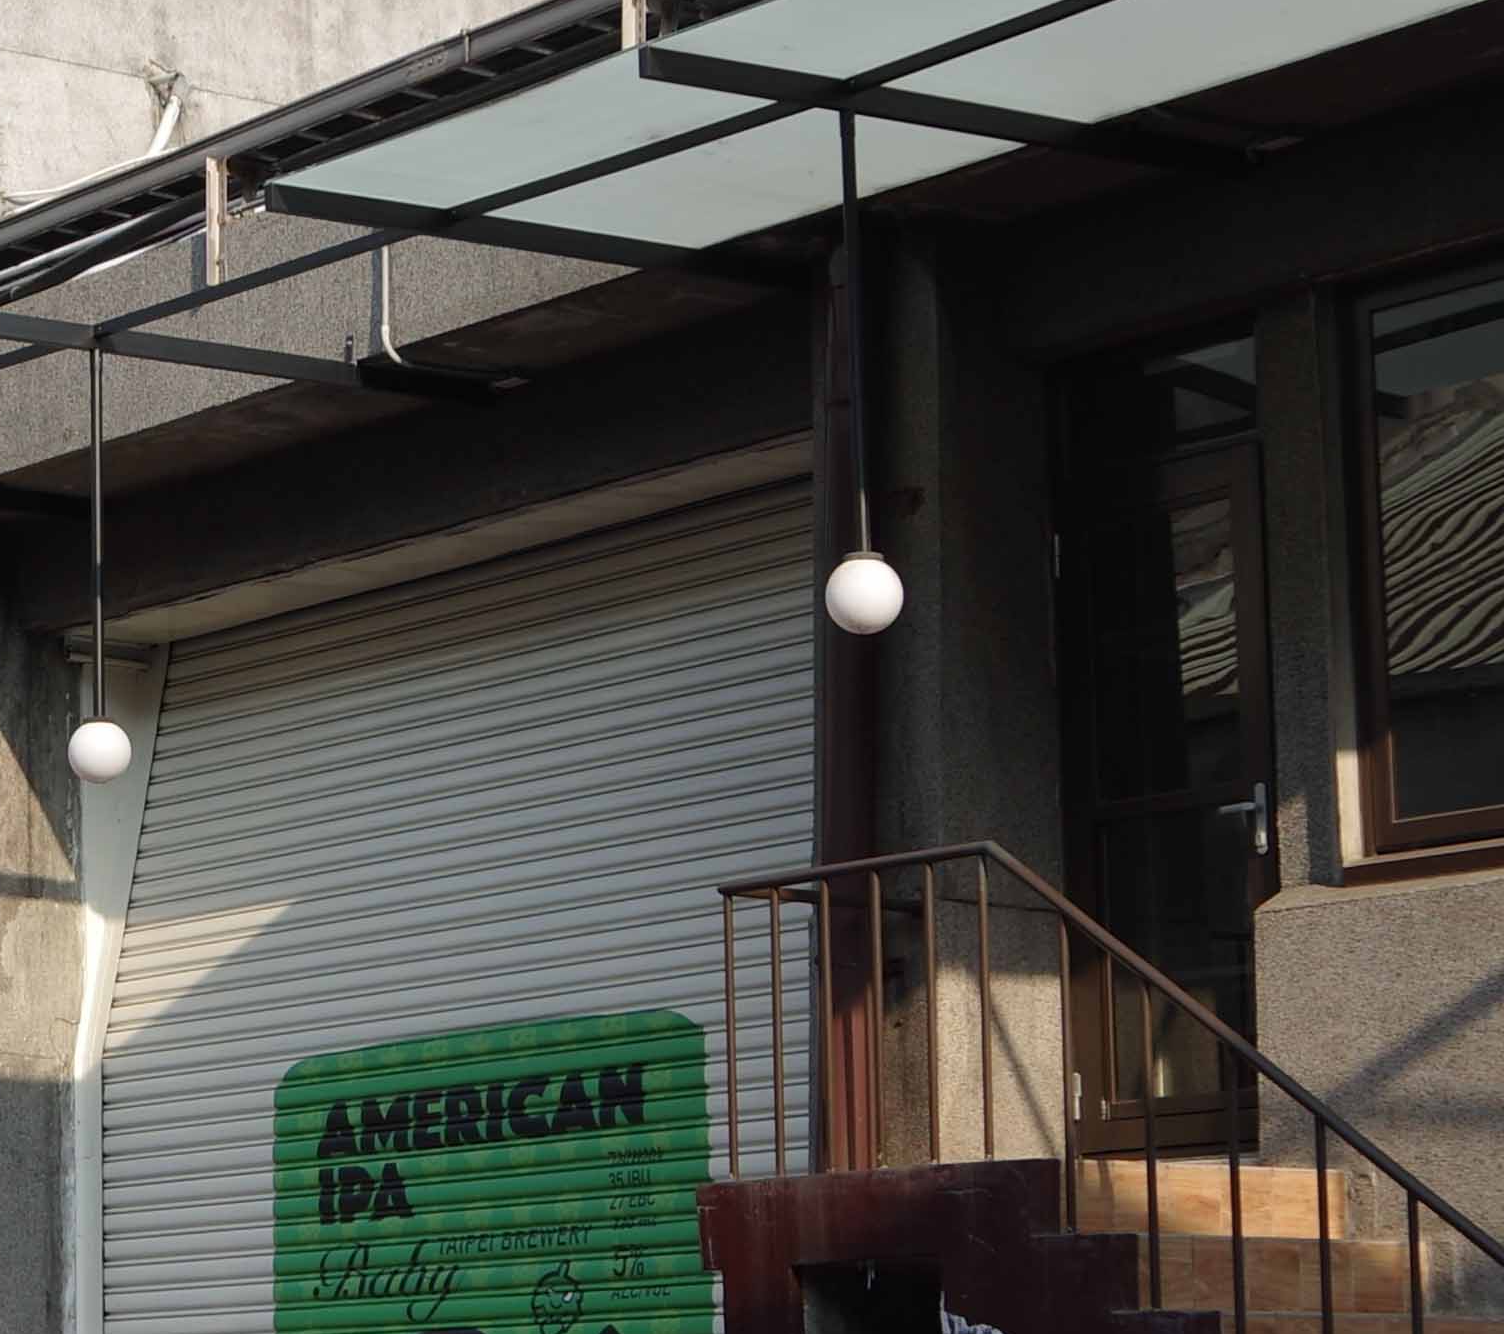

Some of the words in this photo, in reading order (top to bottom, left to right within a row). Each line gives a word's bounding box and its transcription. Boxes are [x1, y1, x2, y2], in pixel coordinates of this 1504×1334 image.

[317, 1062, 646, 1159] AMERICAN
[318, 1162, 416, 1225] IPA
[438, 1233, 495, 1256] TAIPEI
[501, 1225, 593, 1251] BREWERY
[313, 1238, 461, 1323] Baby
